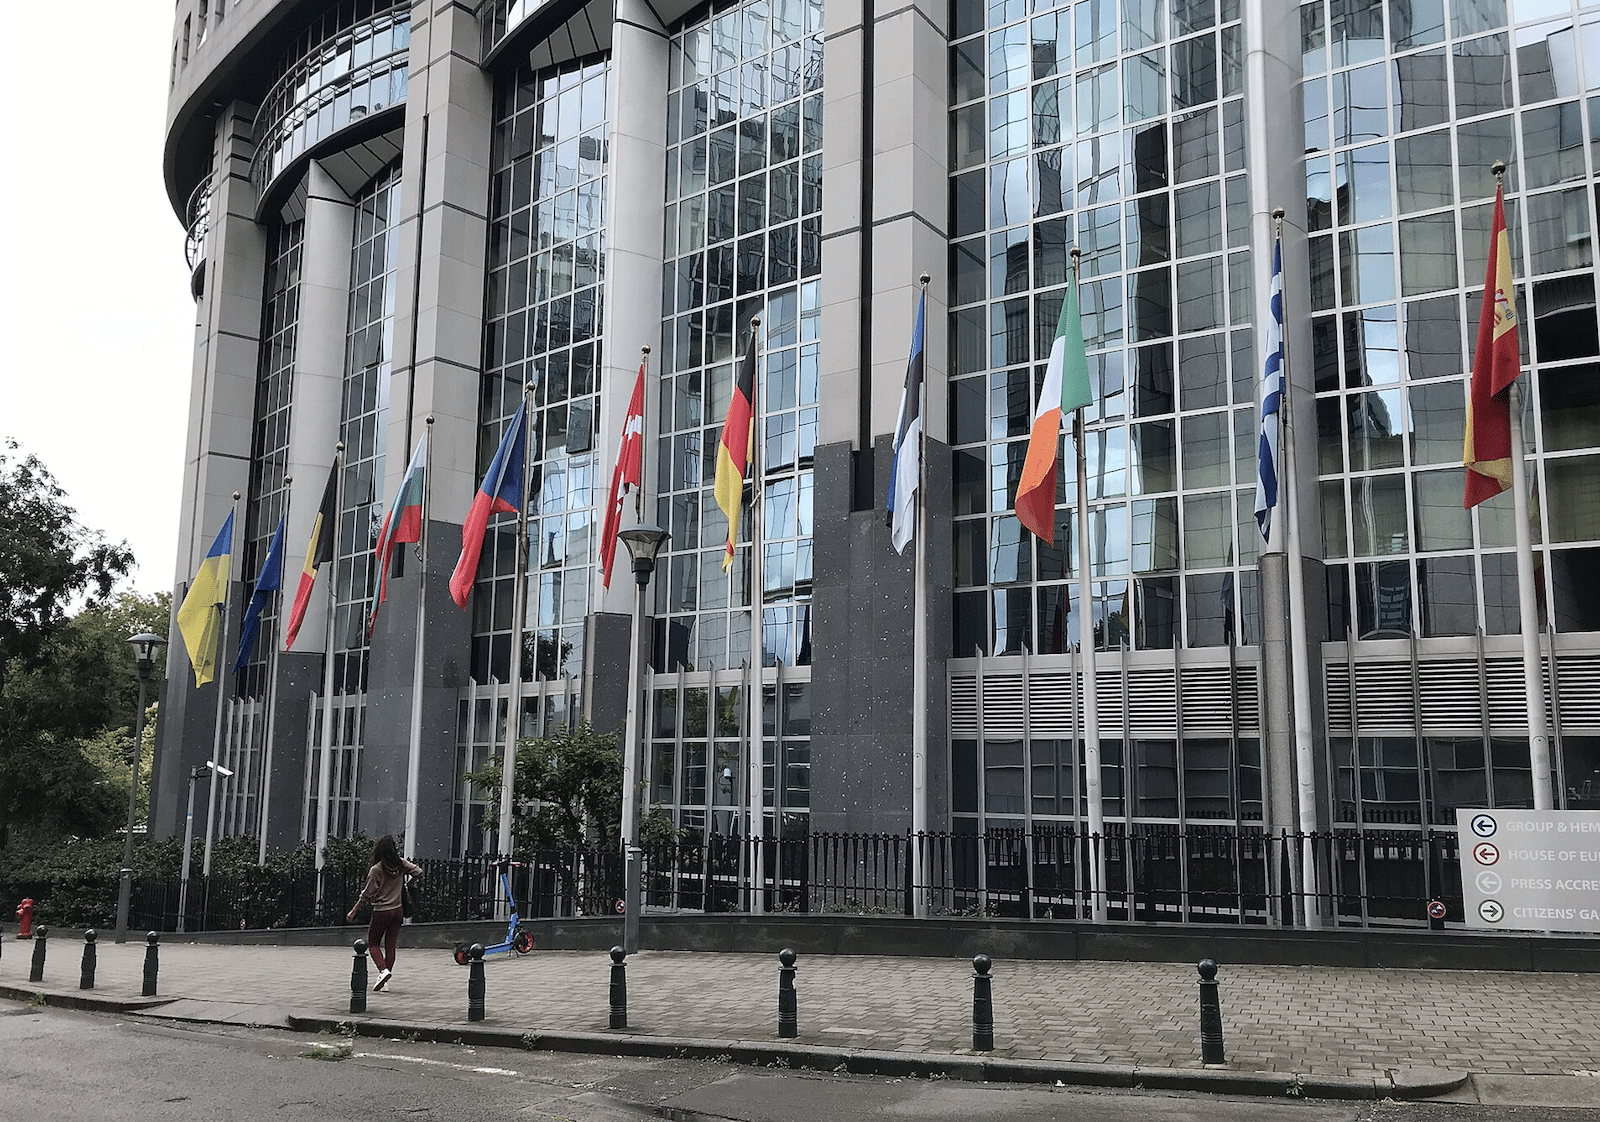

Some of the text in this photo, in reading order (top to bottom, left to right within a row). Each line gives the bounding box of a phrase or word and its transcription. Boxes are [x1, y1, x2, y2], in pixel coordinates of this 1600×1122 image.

[1506, 821, 1554, 832] GROUP
[1557, 822, 1567, 833] &
[1508, 850, 1600, 861] HOUSE OF EU
[1511, 879, 1552, 889] PRESS
[1513, 907, 1576, 919] CITIZENS'
